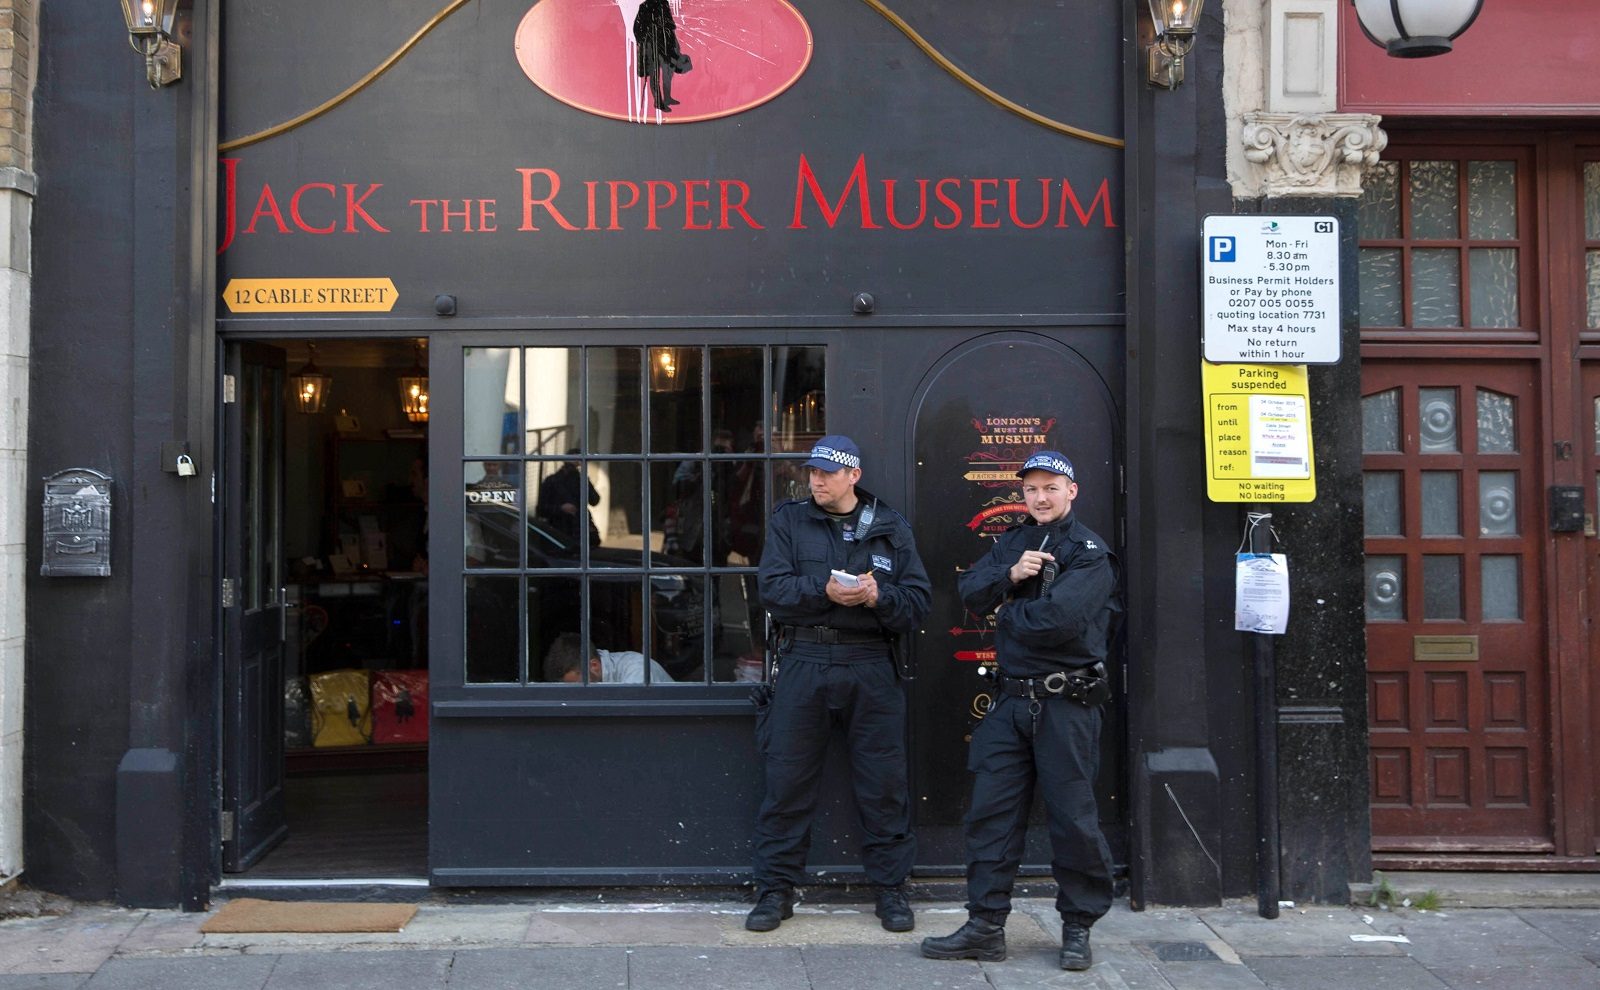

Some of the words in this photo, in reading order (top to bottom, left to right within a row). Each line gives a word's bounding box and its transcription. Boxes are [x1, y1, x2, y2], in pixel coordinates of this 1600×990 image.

[409, 199, 498, 233] THE
[515, 168, 765, 231] RIPPER
[786, 152, 1120, 230] MUSEUM
[1316, 222, 1332, 233] C1
[1266, 240, 1287, 248] Mon
[1295, 240, 1309, 248] Fri
[1214, 238, 1232, 260] P
[1267, 252, 1291, 260] 8.30
[1269, 263, 1293, 271] 5.30
[1295, 264, 1310, 273] pm
[1209, 276, 1253, 285] Business
[1257, 276, 1290, 285] Permit
[1295, 277, 1334, 285] Holders
[235, 290, 251, 304] 12
[255, 288, 313, 304] CABLE
[317, 287, 388, 304] STREET
[1245, 288, 1262, 297] Pay
[1266, 288, 1278, 297] by
[1281, 288, 1312, 298] phone
[1228, 299, 1256, 308] 0207
[1259, 299, 1282, 308] 005
[1285, 299, 1314, 308] 0055
[1217, 311, 1255, 320] quoting
[1259, 311, 1299, 319] location
[1303, 311, 1326, 319] 7731
[1227, 324, 1248, 333] Max
[1252, 324, 1273, 334] stay
[1276, 325, 1283, 333] 4
[1287, 324, 1316, 333] hours
[1247, 338, 1261, 347] No
[1265, 338, 1297, 347] return
[1239, 350, 1270, 358] within
[1274, 350, 1278, 358] 1
[1282, 350, 1305, 358] hour
[1239, 368, 1279, 379] Parking
[1231, 380, 1287, 390] suspended
[1217, 403, 1238, 411] from
[986, 418, 1041, 426] LONDON'S
[981, 435, 1046, 444] MUSEUM
[1218, 434, 1241, 442] place
[1219, 463, 1235, 471] ref:
[1254, 483, 1285, 491] waiting
[469, 490, 516, 503] OPEN
[1254, 492, 1285, 501] loading
